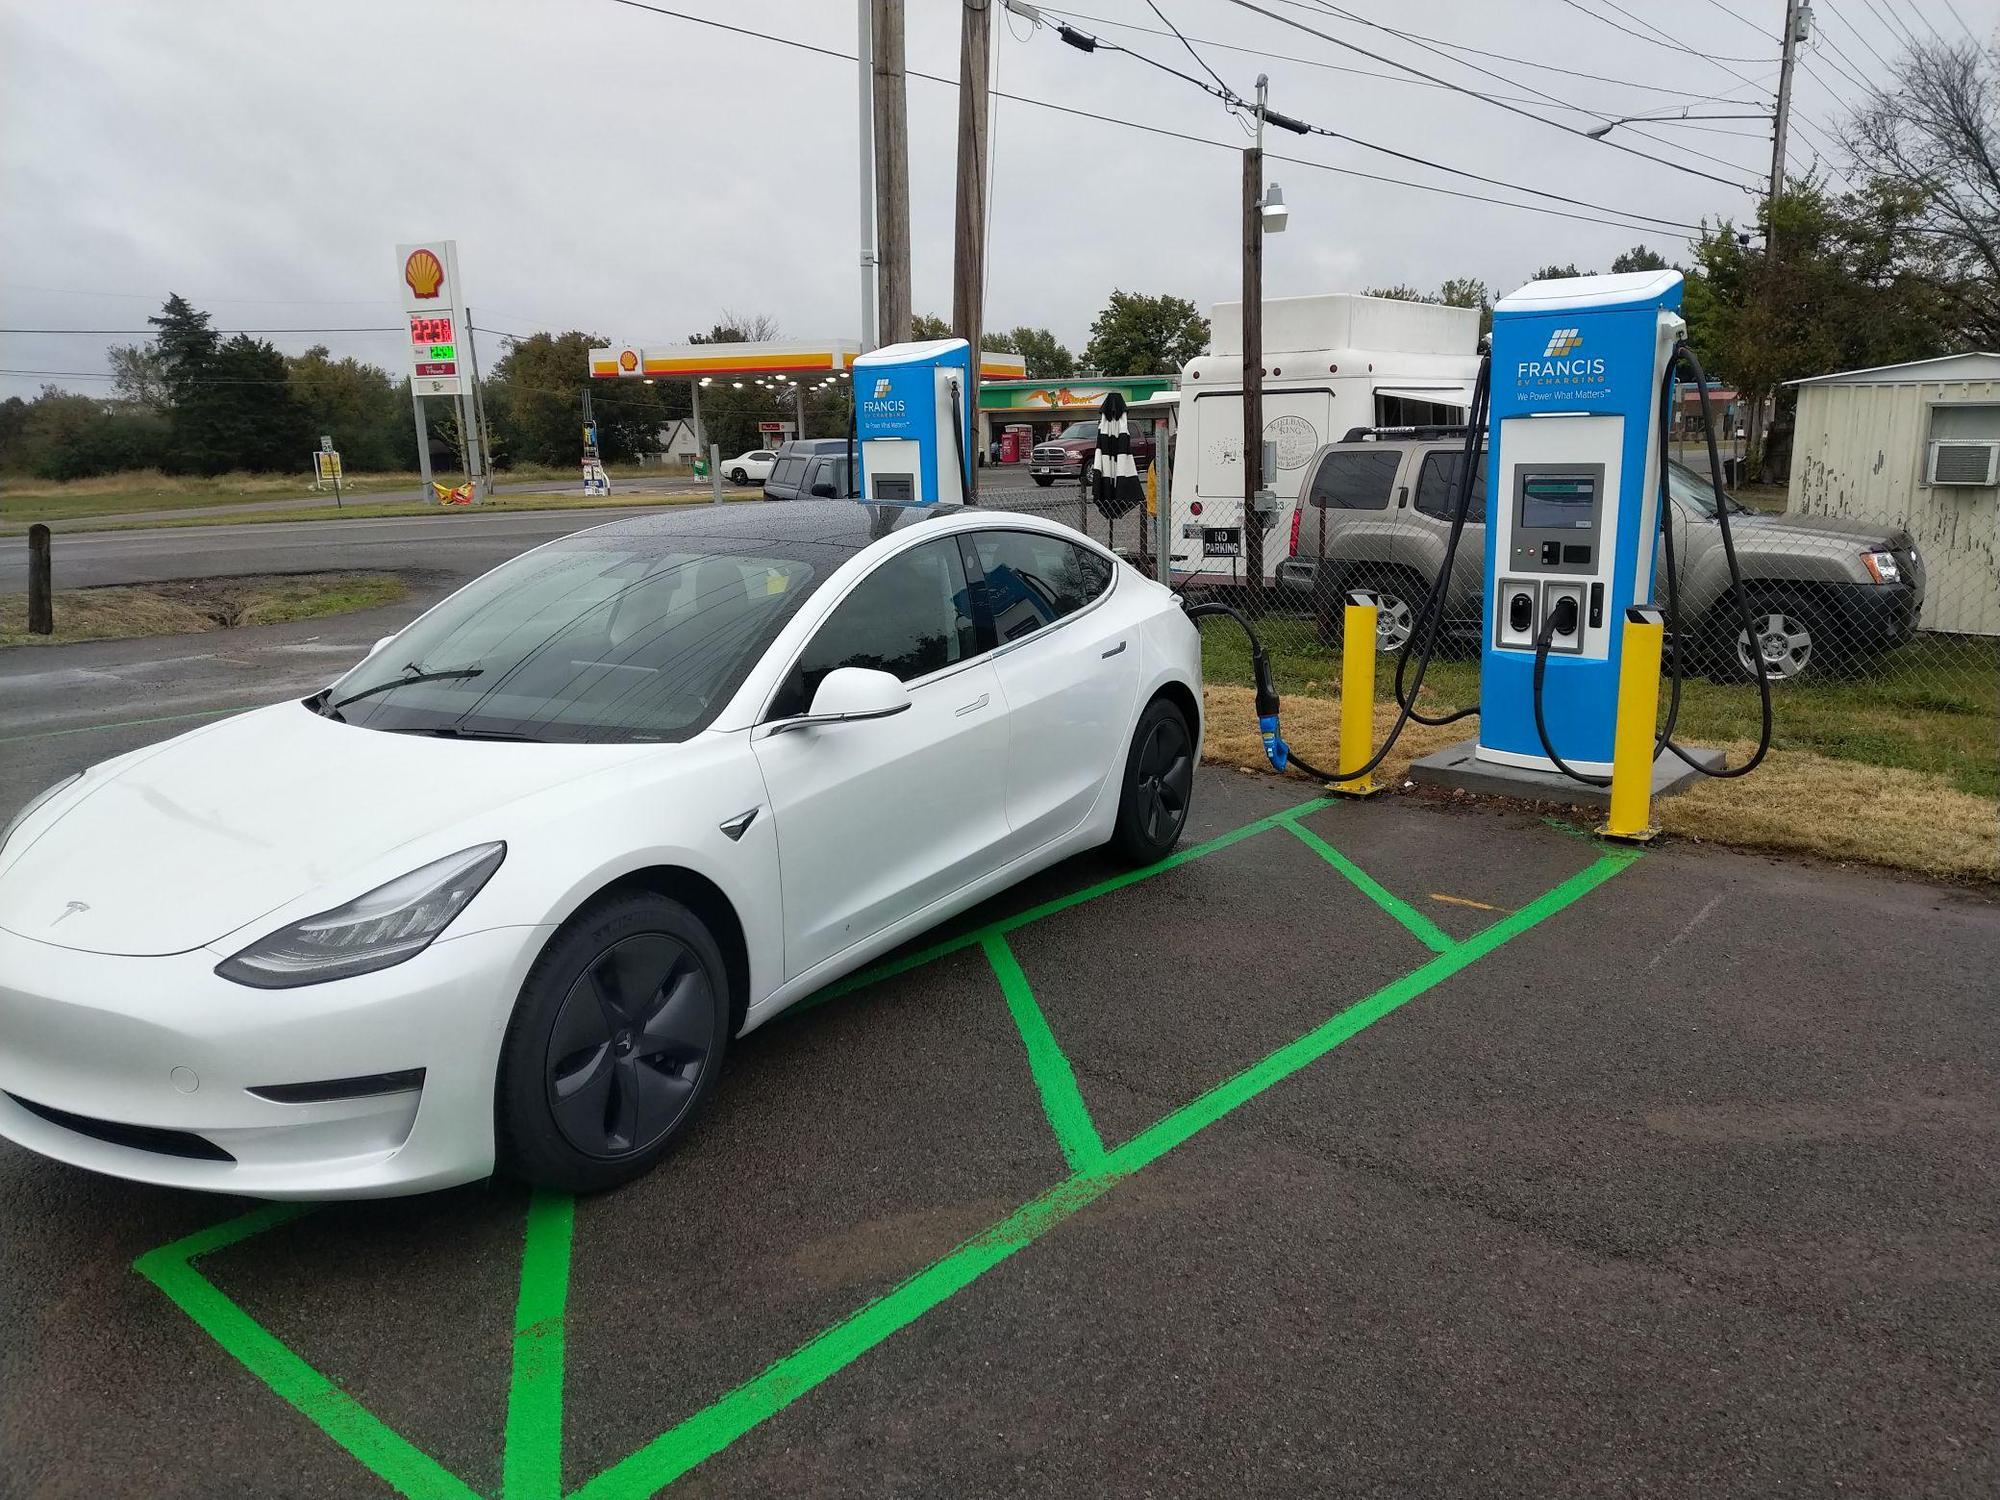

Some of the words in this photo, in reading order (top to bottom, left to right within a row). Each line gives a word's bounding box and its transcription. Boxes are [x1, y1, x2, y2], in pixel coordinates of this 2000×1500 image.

[1518, 358, 1605, 378] FRANCIS
[1537, 376, 1605, 385] CHARGING
[1517, 392, 1528, 400] We
[1529, 391, 1552, 400] Power
[1554, 390, 1574, 400] What
[863, 400, 905, 412] FRANCIS
[1214, 531, 1228, 542] NO
[1205, 543, 1239, 554] PARKING
